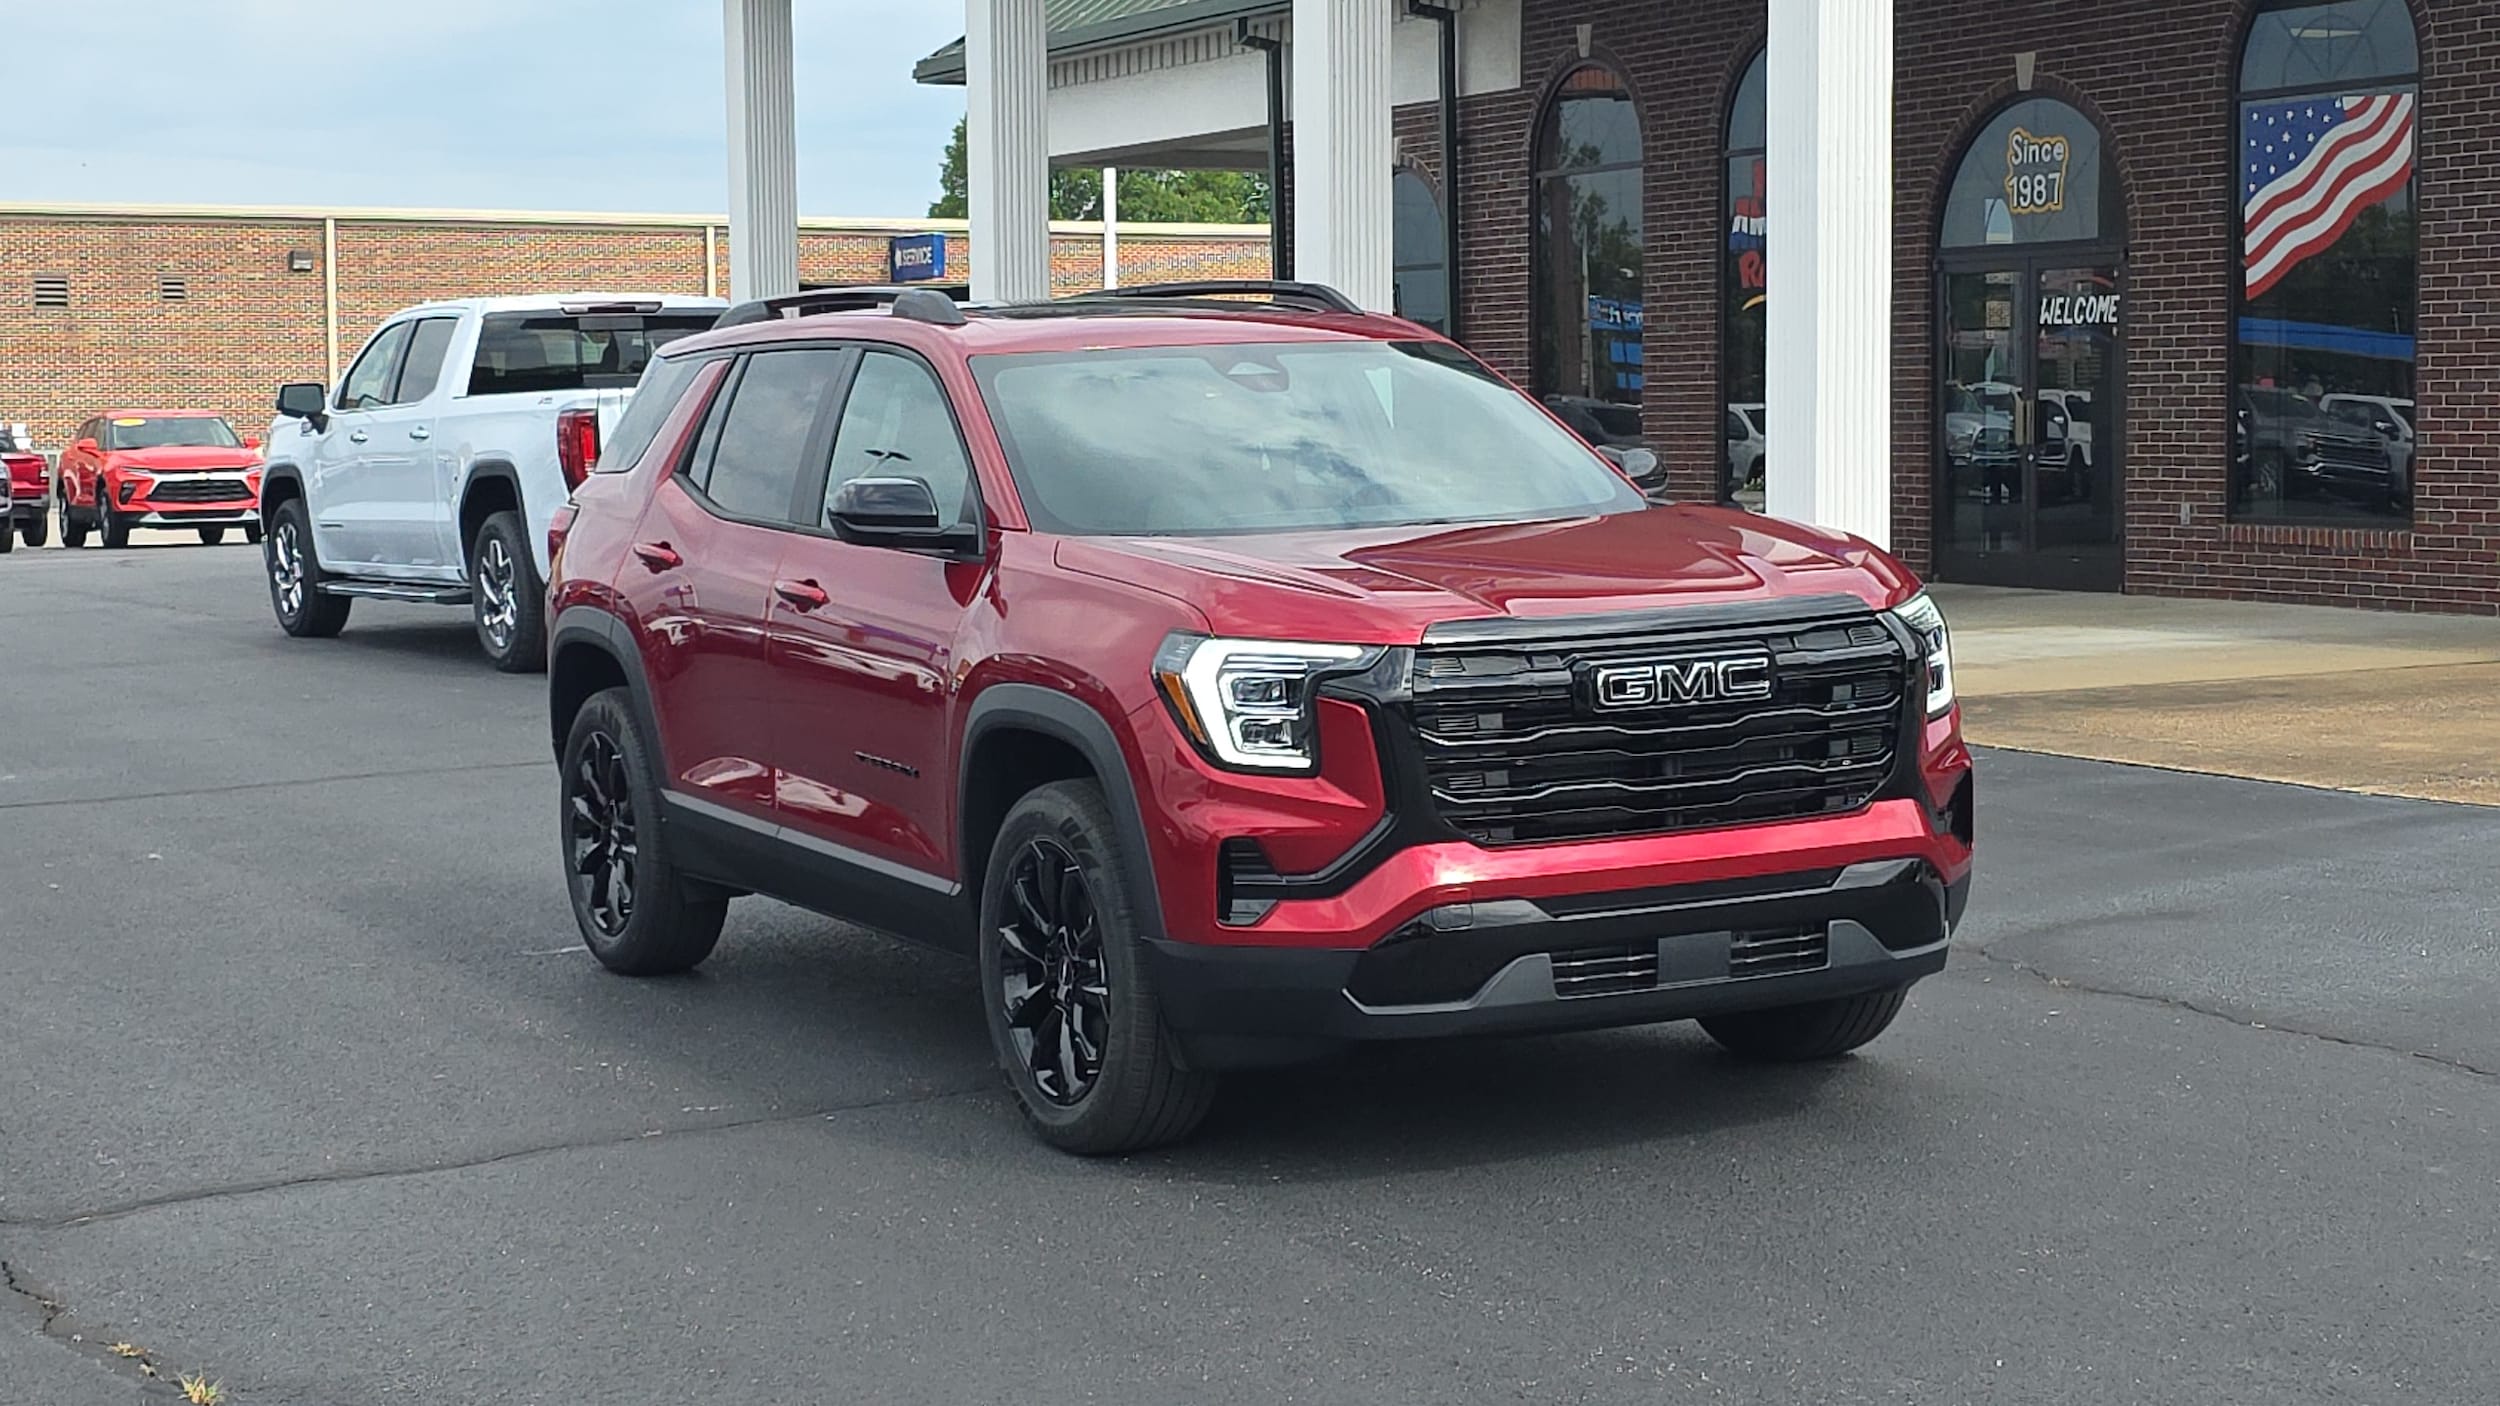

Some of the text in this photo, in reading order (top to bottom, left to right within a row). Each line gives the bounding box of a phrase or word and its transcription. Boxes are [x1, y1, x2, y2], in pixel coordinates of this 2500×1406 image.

[2011, 134, 2065, 166] Since
[2008, 171, 2062, 207] 1987
[902, 246, 932, 266] SERVICE
[2039, 294, 2120, 324] WELCOME
[1597, 657, 1770, 706] GMC
